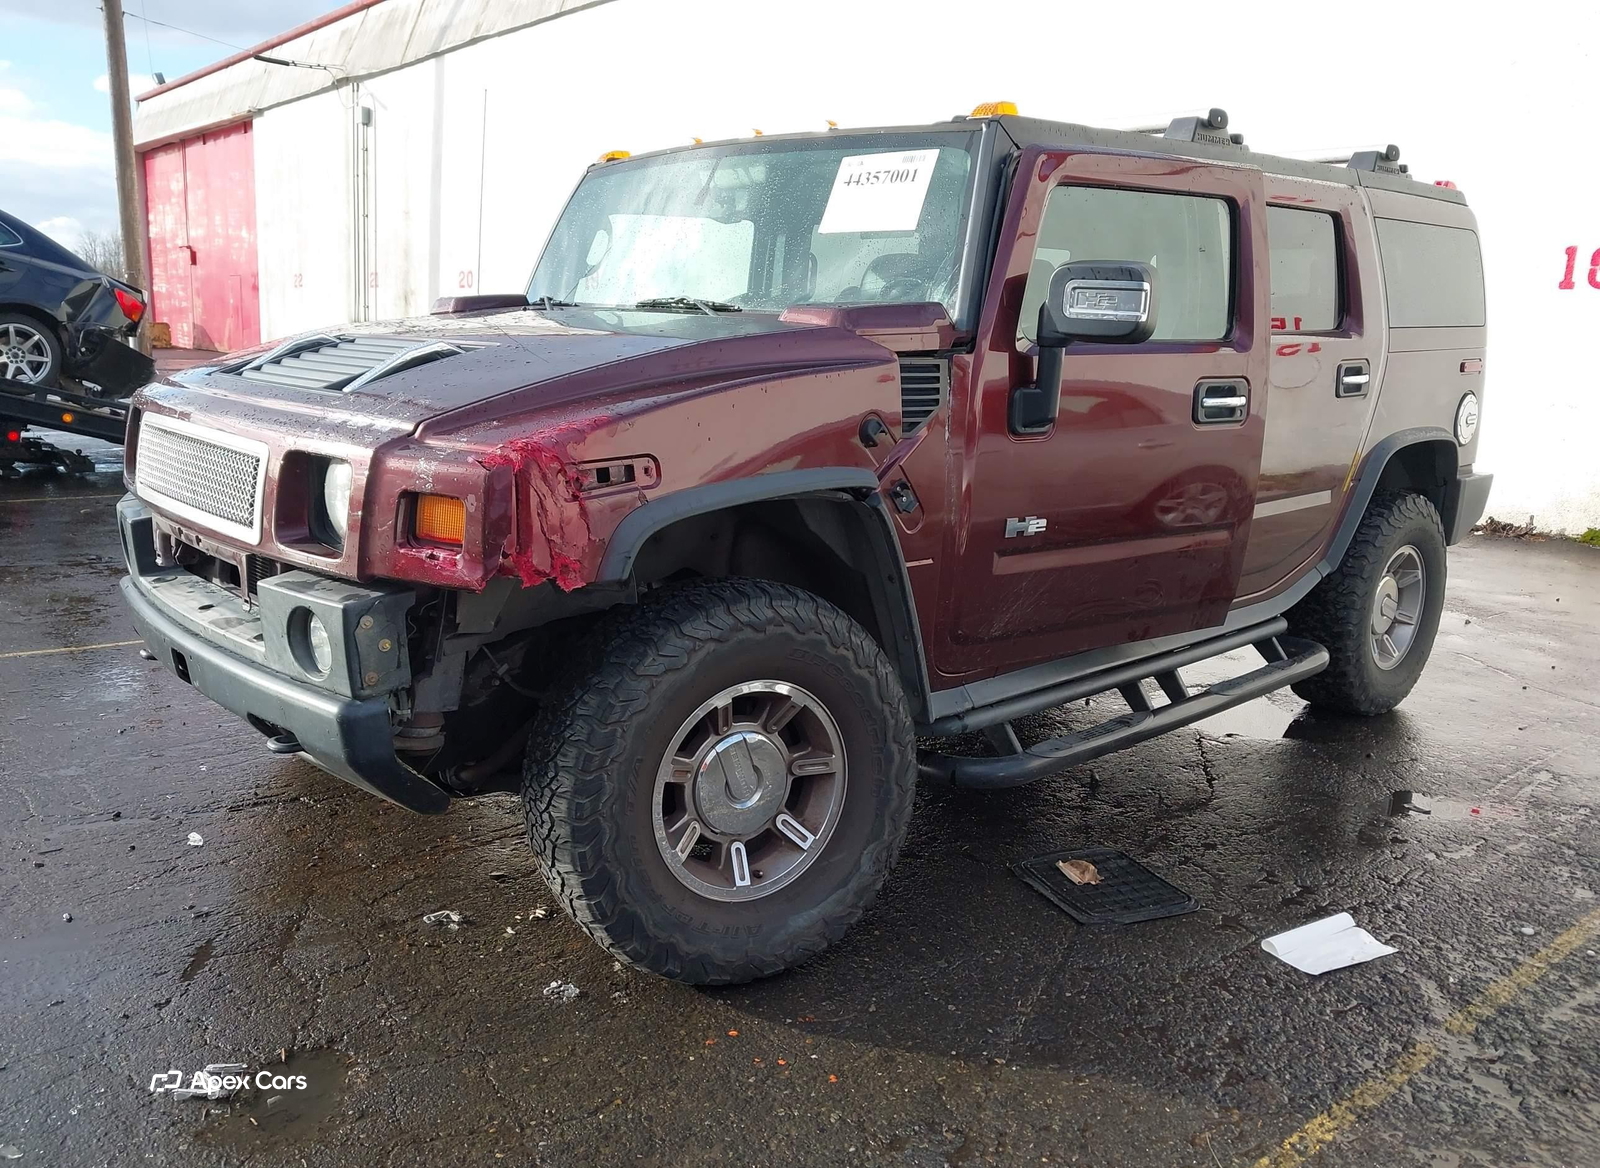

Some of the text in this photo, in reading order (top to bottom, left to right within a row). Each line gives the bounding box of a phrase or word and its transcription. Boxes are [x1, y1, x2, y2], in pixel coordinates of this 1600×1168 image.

[844, 168, 918, 187] 44357001
[293, 272, 303, 289] 22
[458, 270, 474, 289] 20
[1004, 516, 1047, 538] H2
